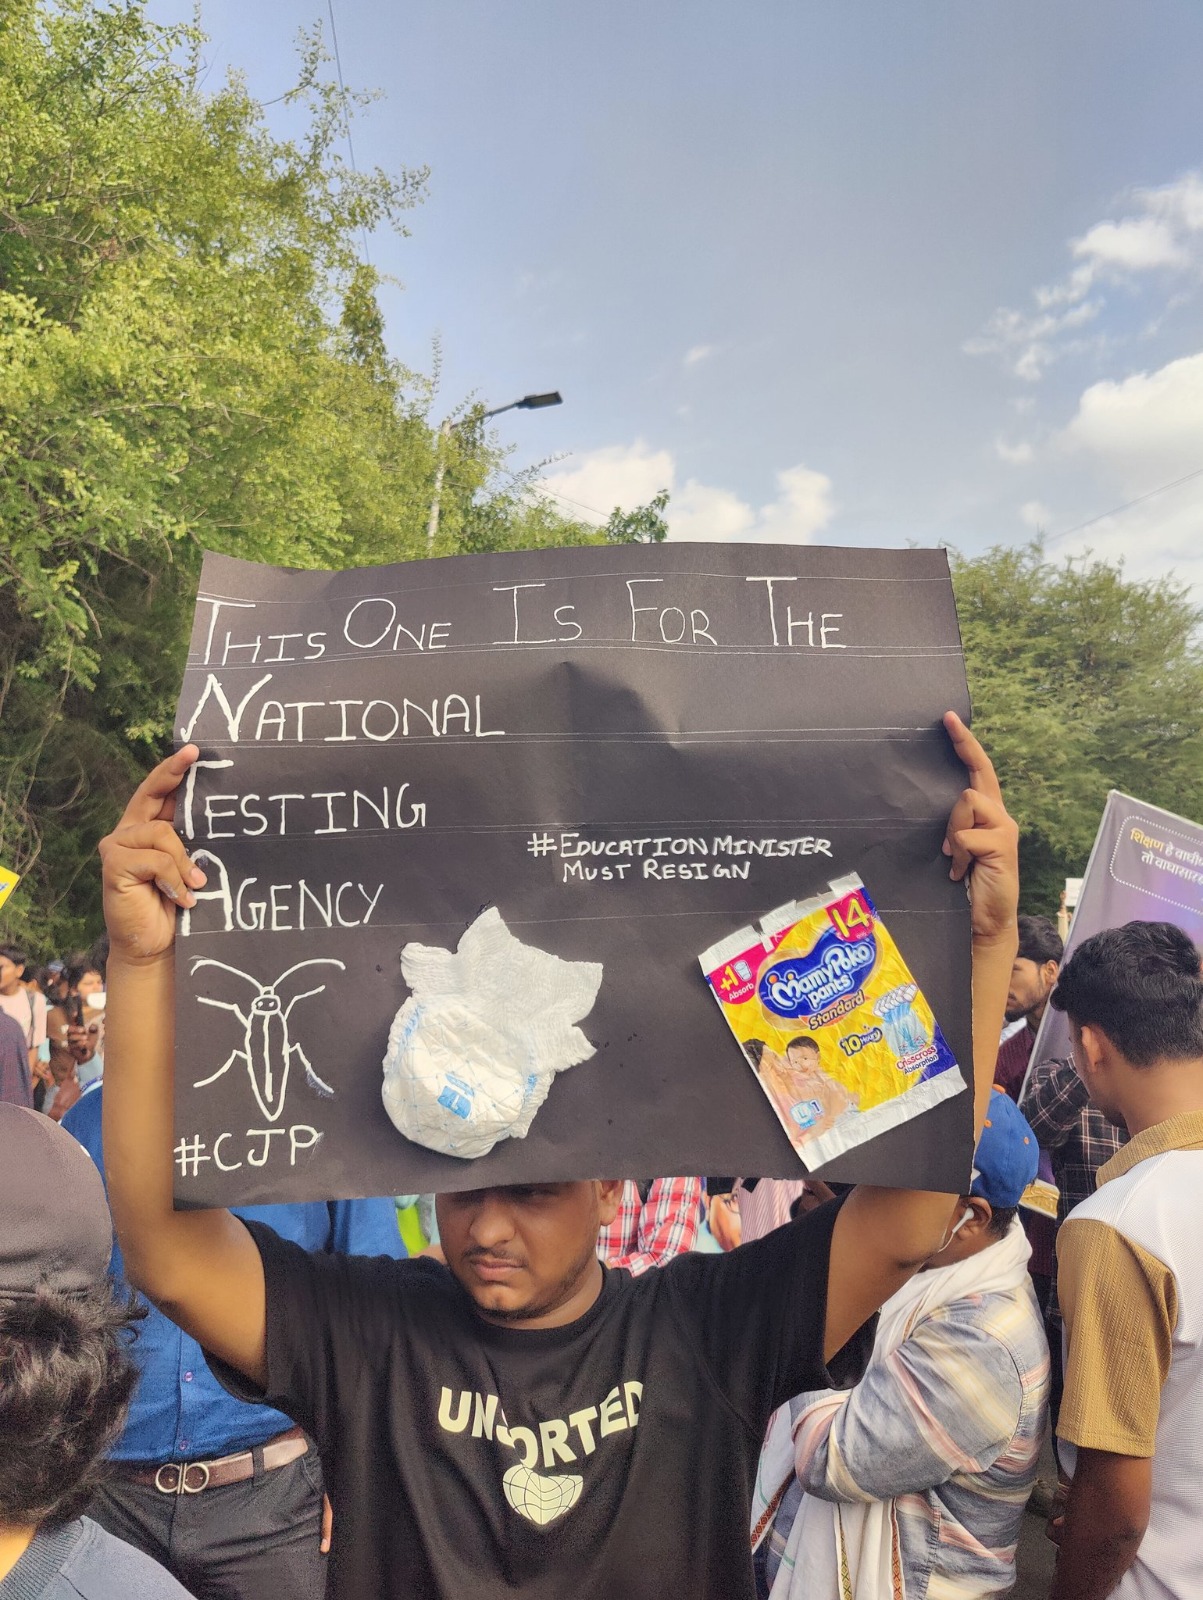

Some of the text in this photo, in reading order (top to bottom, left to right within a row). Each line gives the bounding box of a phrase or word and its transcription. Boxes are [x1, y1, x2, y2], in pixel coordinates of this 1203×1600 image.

[197, 576, 846, 665] THIS ONE IS FOR THE
[180, 673, 505, 742] NATIONAL
[183, 759, 427, 839] TESTING
[1130, 827, 1165, 852] शिक्षण
[1165, 841, 1174, 856] हे
[1141, 850, 1155, 865] तो
[562, 860, 751, 883] MUST RESIGN
[181, 848, 384, 936] AGENCY
[832, 898, 870, 938] 14
[720, 965, 739, 992] +1
[728, 982, 755, 1001] Absorb
[769, 943, 873, 1008] MamyPoko
[807, 974, 851, 1009] pants
[808, 989, 865, 1030] Standard
[840, 1033, 862, 1056] 10
[896, 1047, 937, 1069] Crisscross
[904, 1054, 938, 1075] Absorption
[174, 1125, 320, 1177] #CJP
